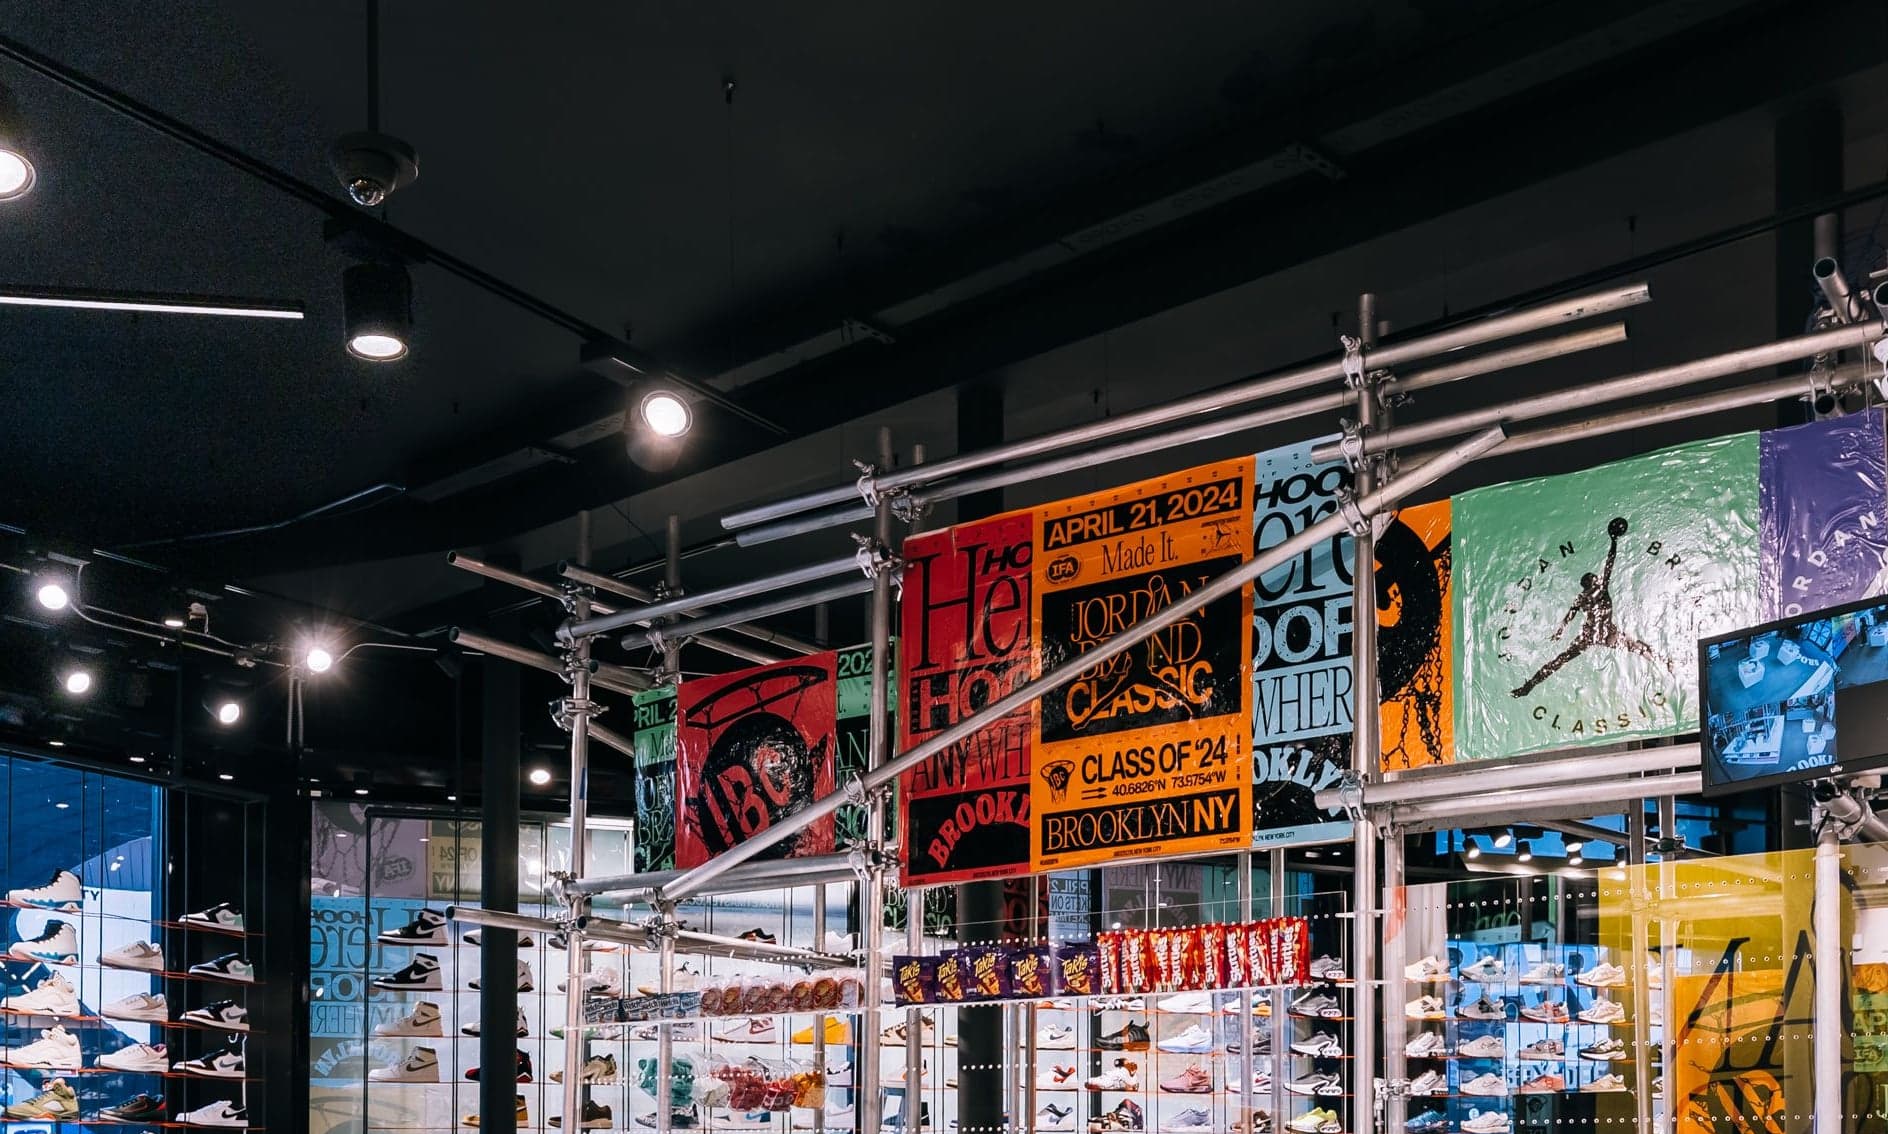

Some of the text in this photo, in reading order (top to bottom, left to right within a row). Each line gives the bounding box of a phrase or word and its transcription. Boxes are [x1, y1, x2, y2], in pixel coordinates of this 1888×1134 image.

[1048, 481, 1239, 548] APRIL 21, 2024
[1101, 530, 1179, 576] Made It.
[1052, 562, 1075, 578] IFA
[1066, 660, 1214, 724] CLASSIC
[1532, 692, 1667, 734] CLASSIC
[1081, 746, 1155, 786] CLASS
[1159, 741, 1191, 774] OF
[1112, 779, 1166, 797] 40.6826°N
[1046, 794, 1237, 851] BROOKLYN NY
[899, 961, 920, 985] Takis
[936, 958, 958, 983] Takis
[973, 954, 996, 978] Takis
[1016, 956, 1039, 980] Takis
[1062, 956, 1088, 981] Takis
